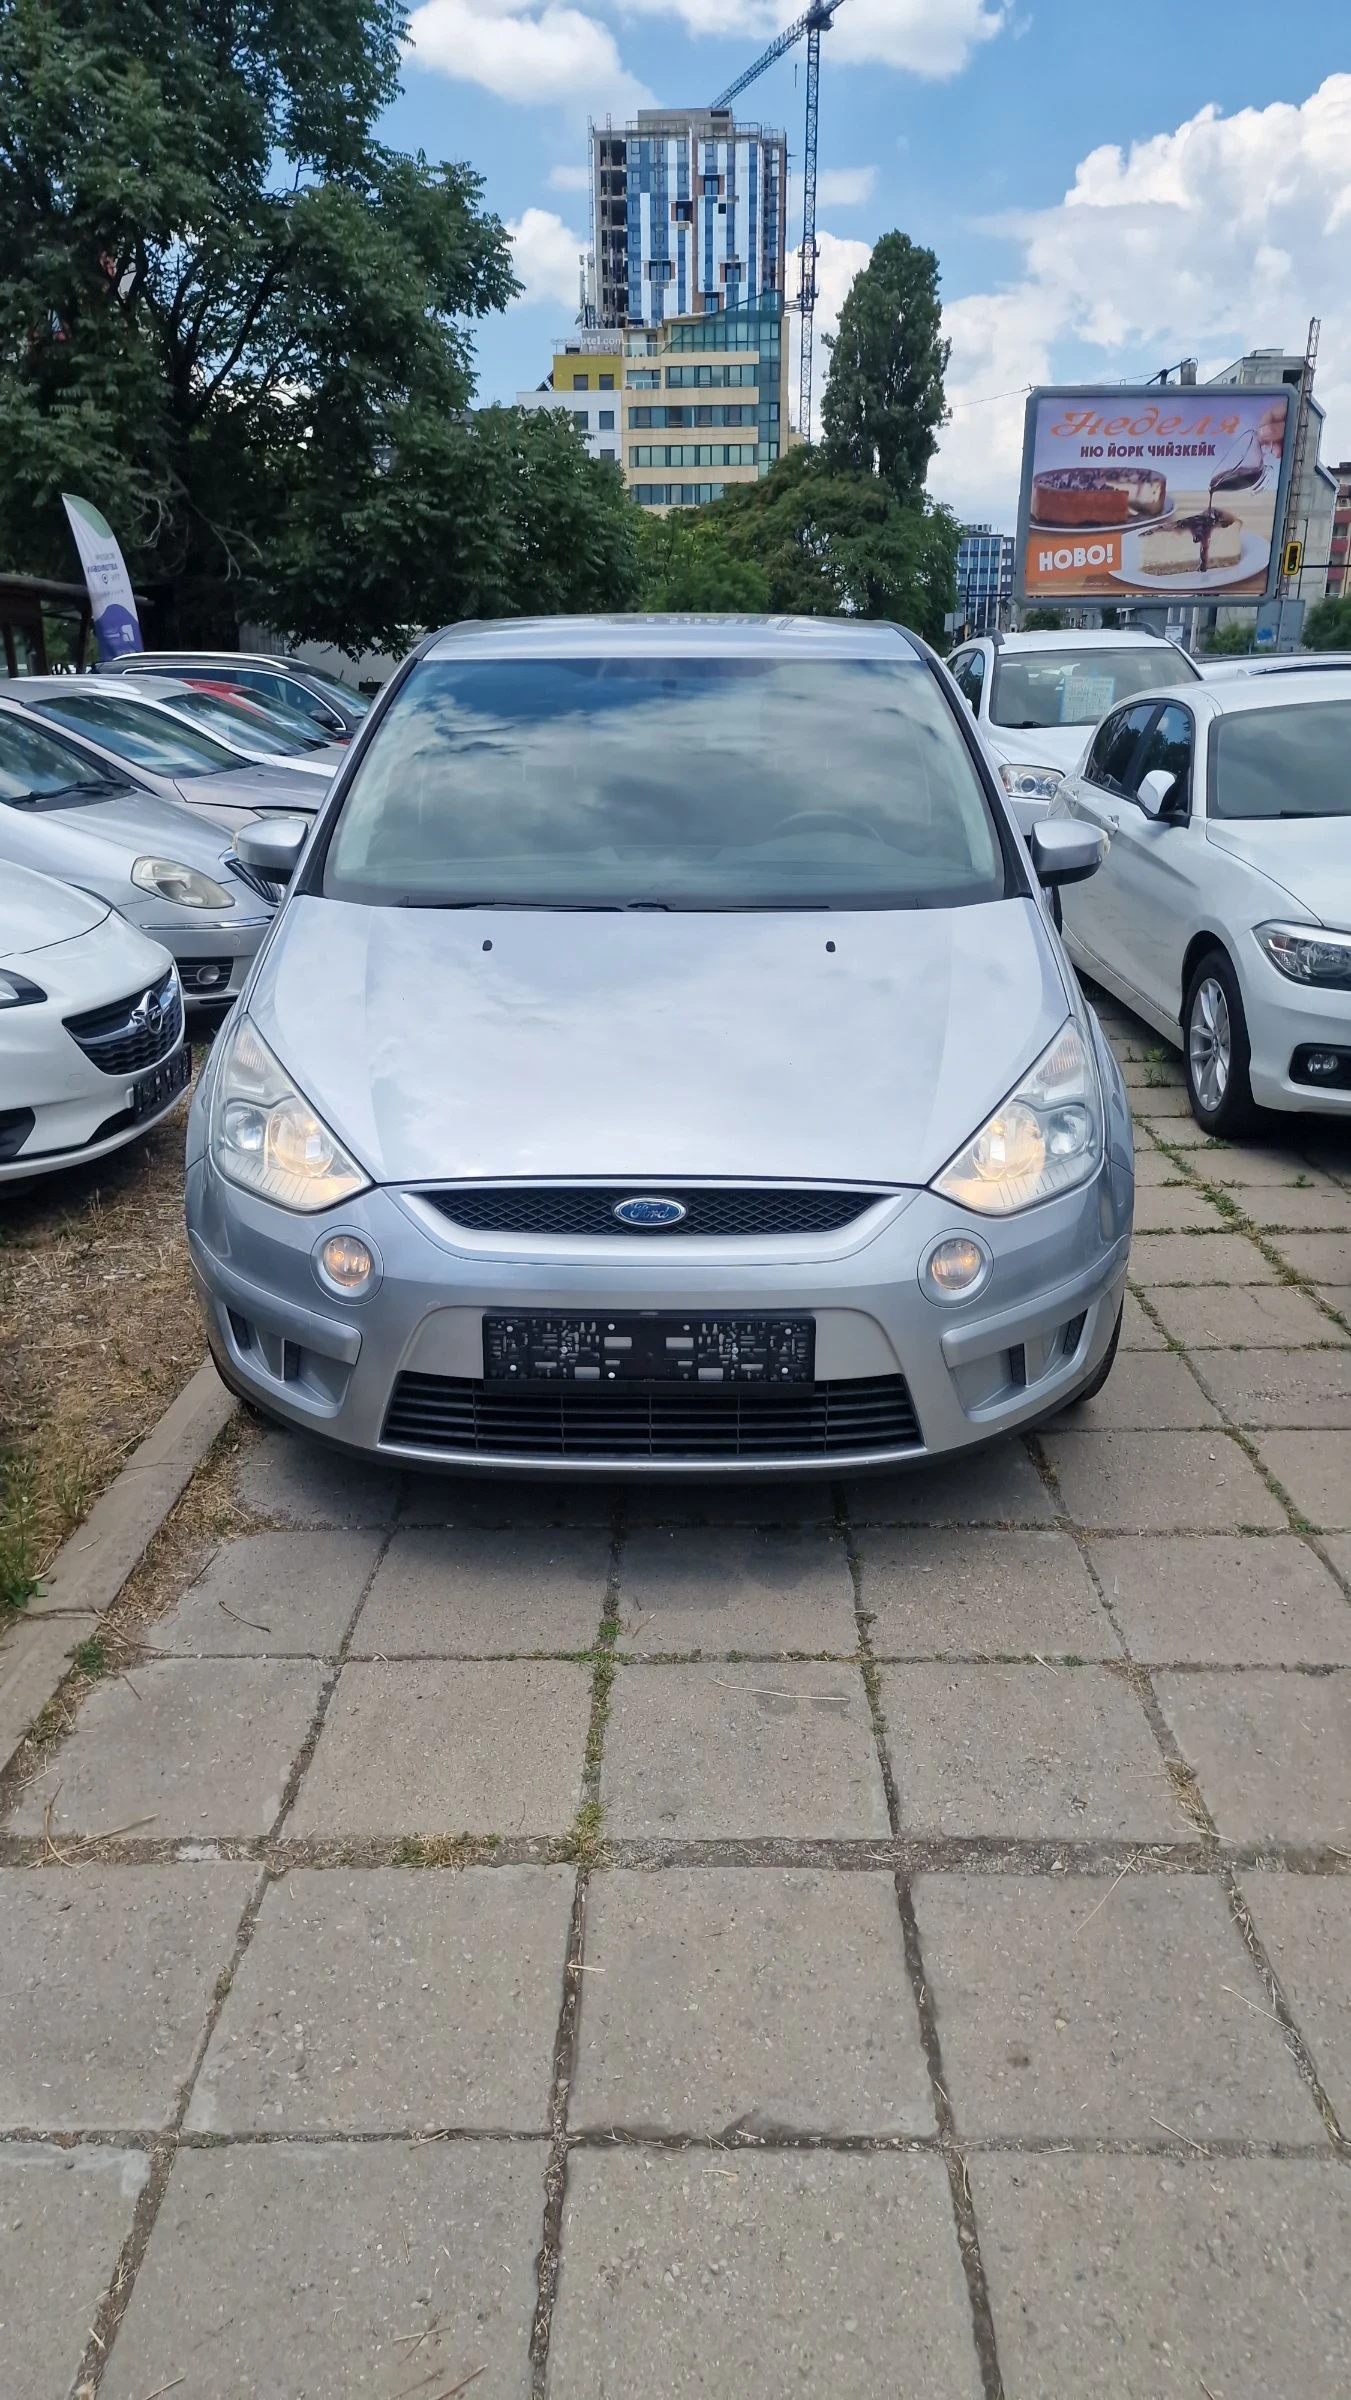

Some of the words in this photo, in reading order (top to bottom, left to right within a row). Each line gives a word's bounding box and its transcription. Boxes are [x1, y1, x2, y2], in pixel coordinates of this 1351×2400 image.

[1051, 405, 1240, 437] Неделя
[1080, 446, 1104, 458] НЮ
[1107, 443, 1144, 458] ЙОРК
[1148, 441, 1216, 457] ЧИЙЗКЕЙК
[1039, 543, 1114, 572] НОВО!
[629, 1202, 670, 1220] Ford
